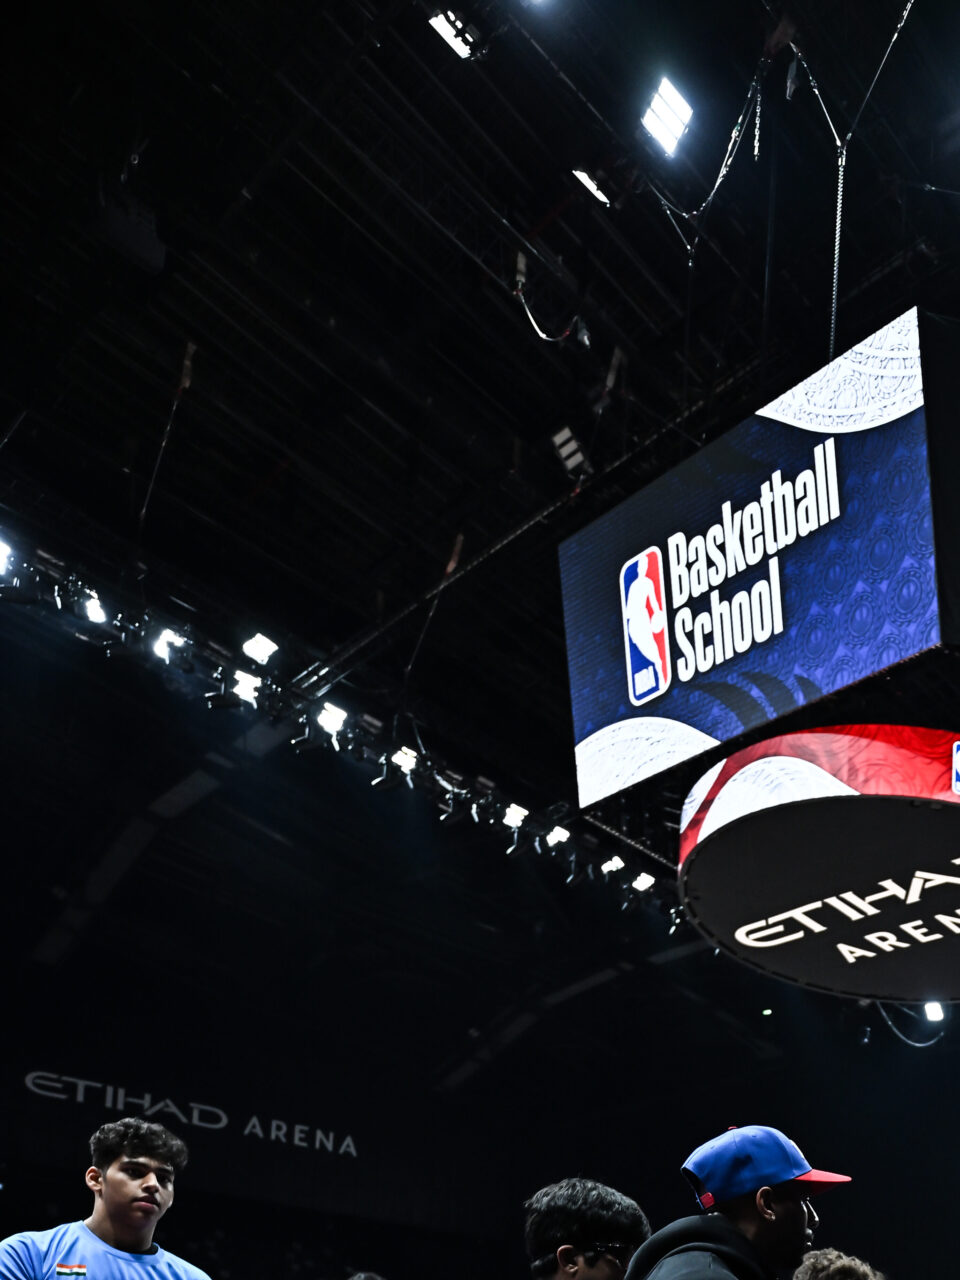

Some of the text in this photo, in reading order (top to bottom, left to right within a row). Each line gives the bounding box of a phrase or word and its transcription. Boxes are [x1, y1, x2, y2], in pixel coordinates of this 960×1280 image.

[667, 436, 840, 609] Basketball
[674, 555, 784, 682] School
[24, 1070, 358, 1158] ETIHAD ARENA
